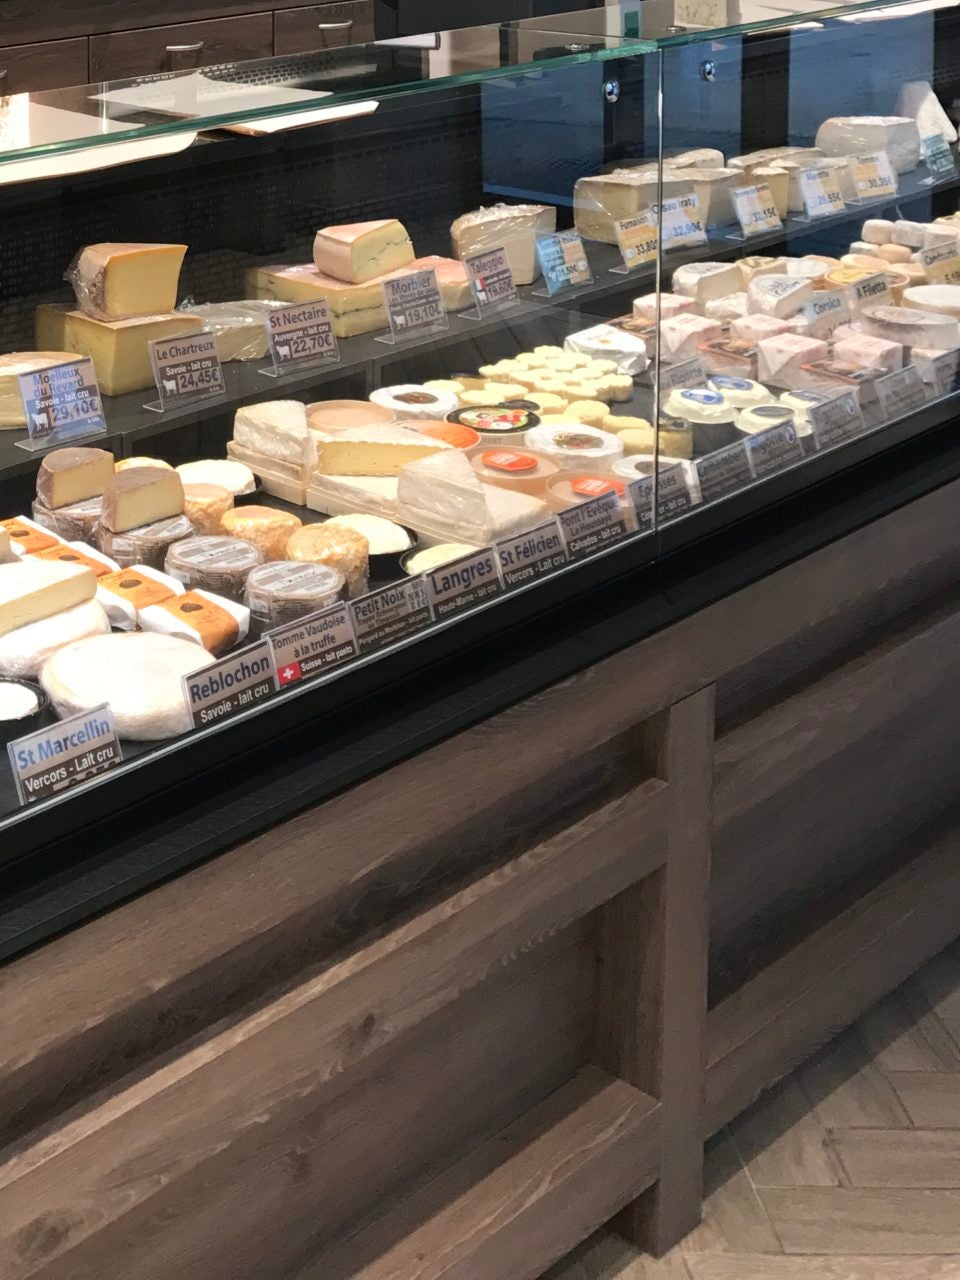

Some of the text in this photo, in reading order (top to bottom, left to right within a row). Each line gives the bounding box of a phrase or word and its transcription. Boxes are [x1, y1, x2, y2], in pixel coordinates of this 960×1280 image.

[672, 220, 703, 237] 32,90€
[470, 256, 503, 274] Taleggio
[391, 277, 431, 296] Morbier
[269, 306, 327, 328] St Nectaire
[407, 303, 442, 322] 19,10€
[813, 297, 841, 315] Corsica
[274, 329, 304, 342] Auvergne
[292, 334, 332, 354] 22,70€
[156, 341, 215, 360] Le Chartreux
[33, 367, 80, 386] Moelleux
[165, 364, 187, 376] Savoie
[180, 368, 219, 389] 24,45€
[34, 375, 85, 398] du Revard
[35, 389, 89, 409] Savoie lait cru
[52, 398, 99, 422] 29,10€
[638, 475, 677, 499] Epsses
[560, 511, 581, 527] Pont
[499, 534, 560, 567] St Félicien
[570, 535, 599, 552] Calvados
[431, 558, 493, 595] Langres
[505, 554, 565, 585] Vercors Lait cru
[354, 588, 406, 620] Petit Noix
[271, 614, 346, 650] Tomme Vaudoise
[300, 645, 310, 656] la
[310, 633, 337, 652] truffe
[301, 658, 322, 672] Suisse
[336, 645, 353, 659] pasto
[190, 656, 270, 704] Reblochon
[200, 683, 270, 723] Savoie lait cru
[17, 718, 111, 770] St Marcellin
[24, 766, 68, 793] Vercors
[74, 752, 96, 772] Lait
[96, 746, 114, 762] cru
